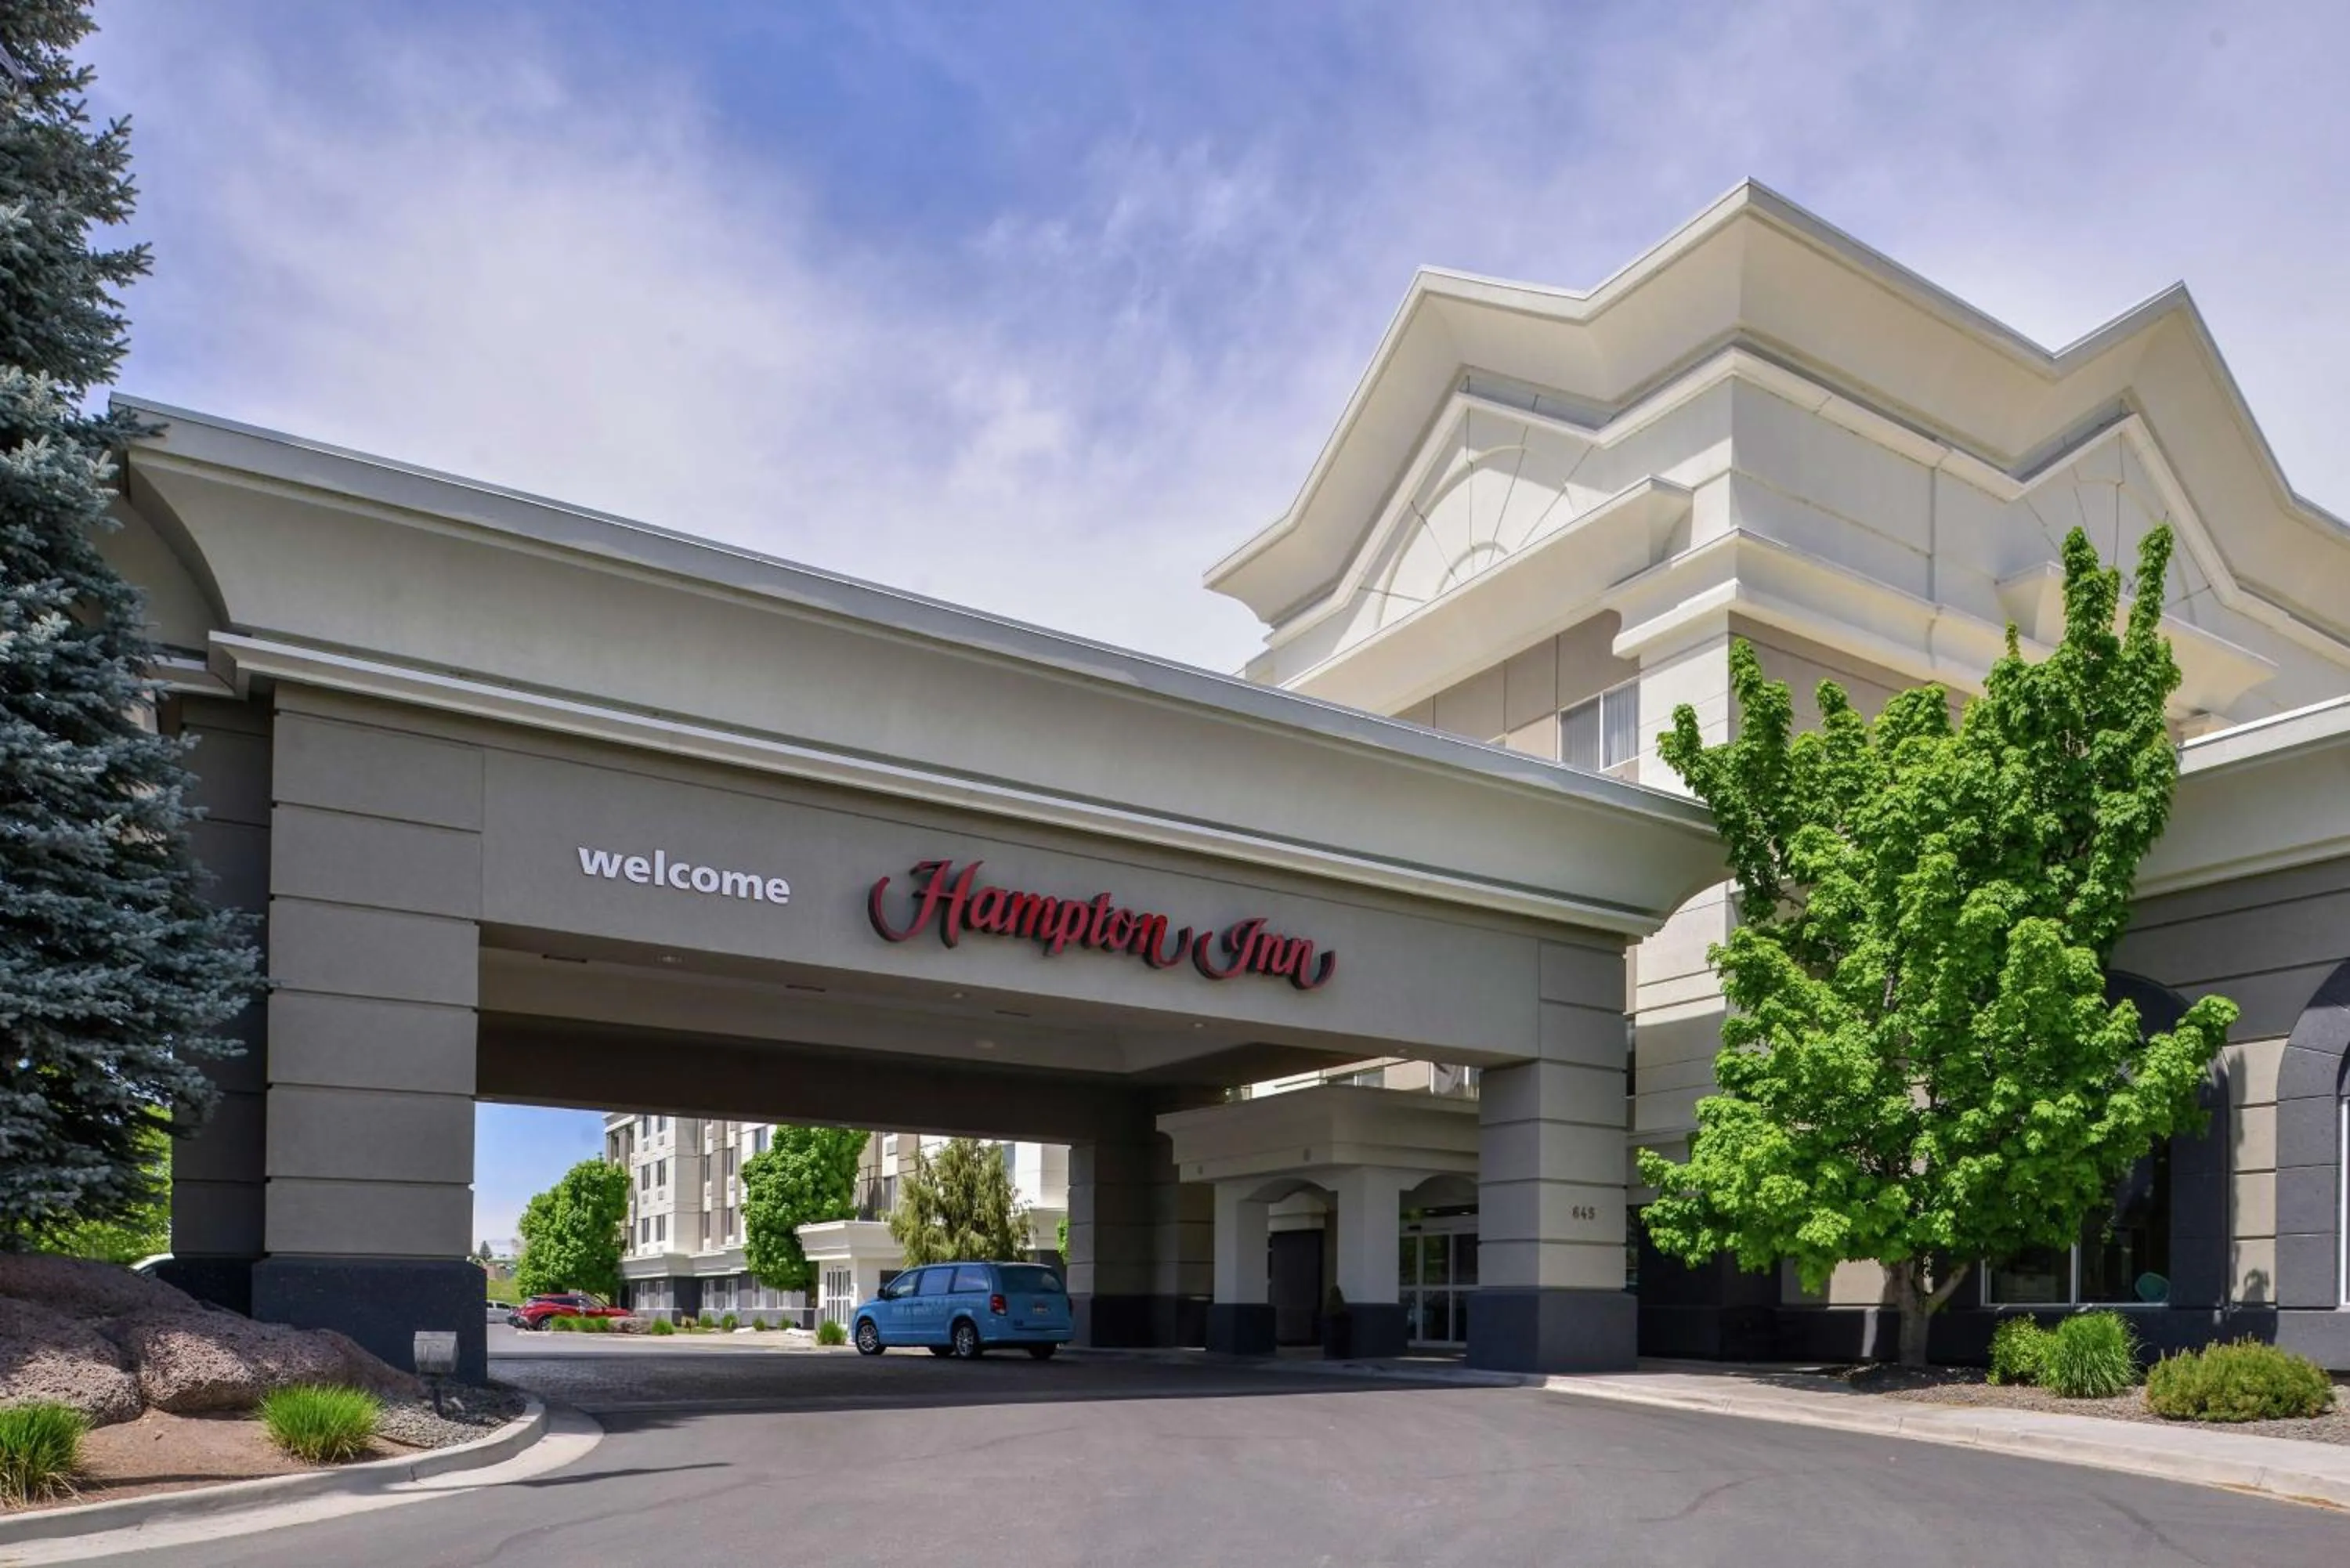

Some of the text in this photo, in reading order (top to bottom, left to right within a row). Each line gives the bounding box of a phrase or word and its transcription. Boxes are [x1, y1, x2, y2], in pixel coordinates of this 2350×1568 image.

[577, 847, 790, 904] welcome
[867, 860, 1335, 990] Hampton Inn
[1572, 1205, 1595, 1220] 645
